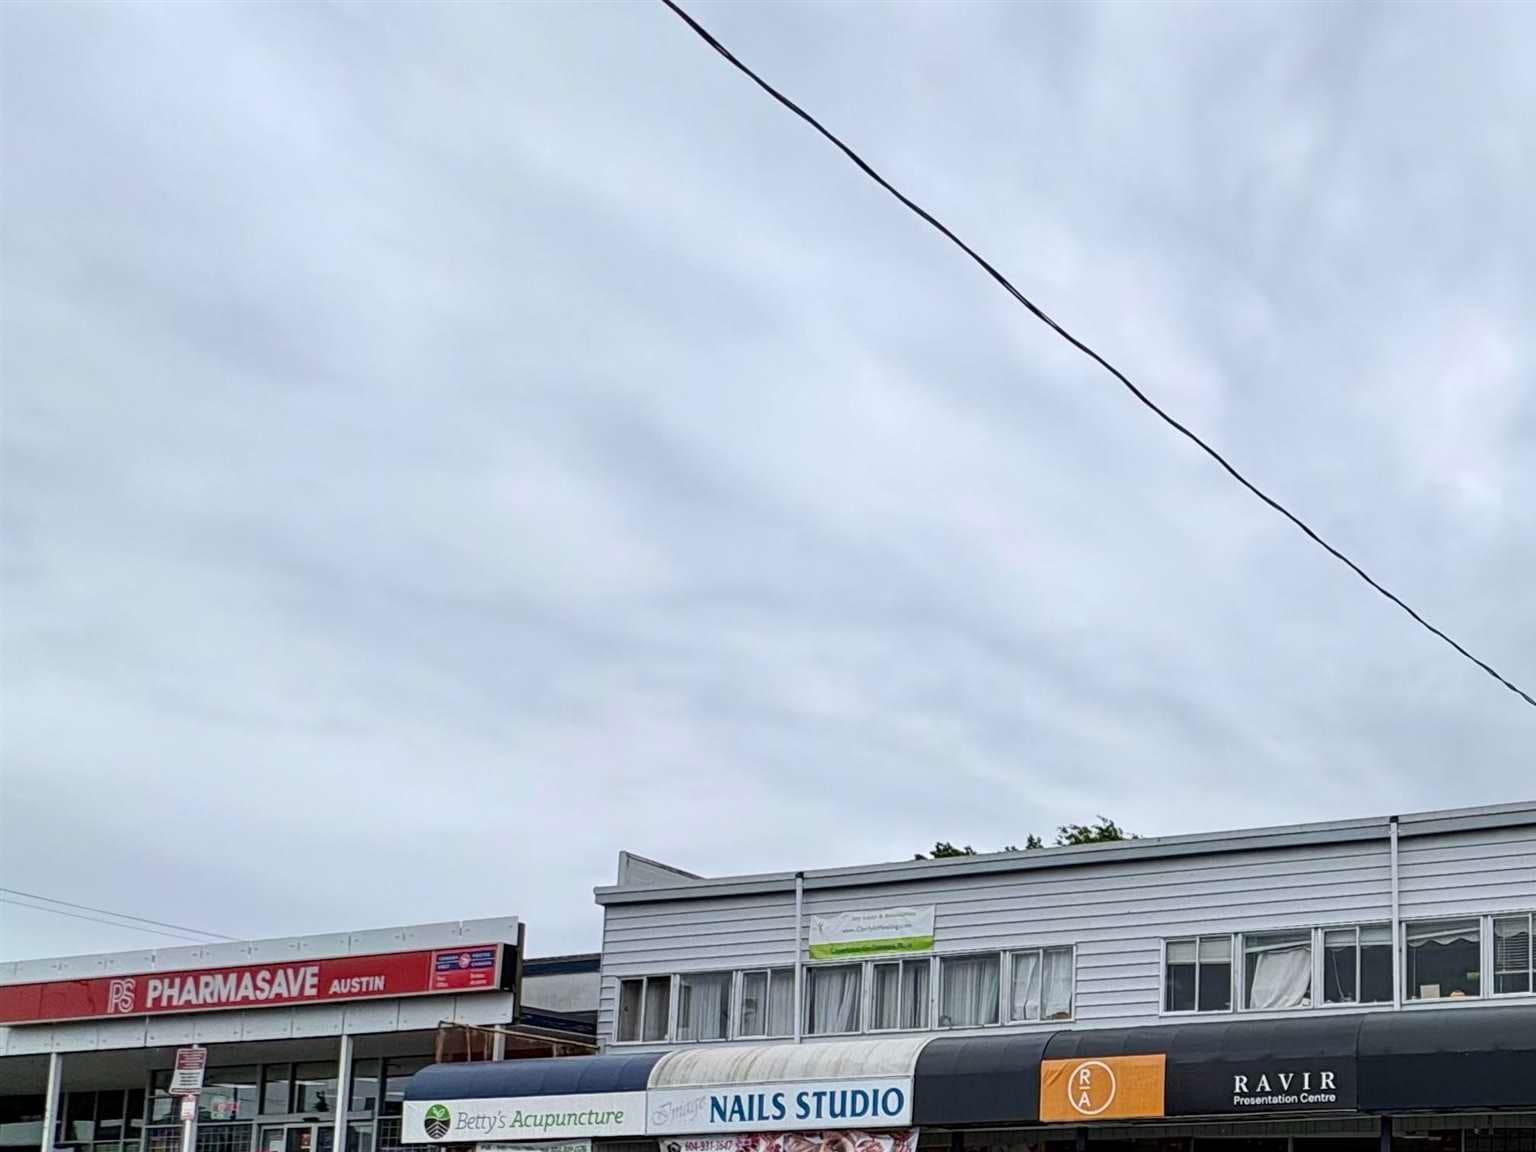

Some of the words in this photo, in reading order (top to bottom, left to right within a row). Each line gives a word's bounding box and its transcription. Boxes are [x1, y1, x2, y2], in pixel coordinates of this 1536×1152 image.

[146, 965, 319, 1008] PHARMASAVE
[329, 975, 385, 994] AUSTIN
[1079, 1068, 1091, 1085] R
[1233, 1071, 1336, 1093] RAVIR
[709, 1092, 786, 1123] NAILS
[795, 1087, 905, 1120] STUDIO
[1078, 1090, 1091, 1107] A
[1233, 1093, 1299, 1105] Presentation
[1300, 1092, 1337, 1103] Centre
[456, 1110, 507, 1135] Betty's
[509, 1109, 624, 1132] Acupuncture
